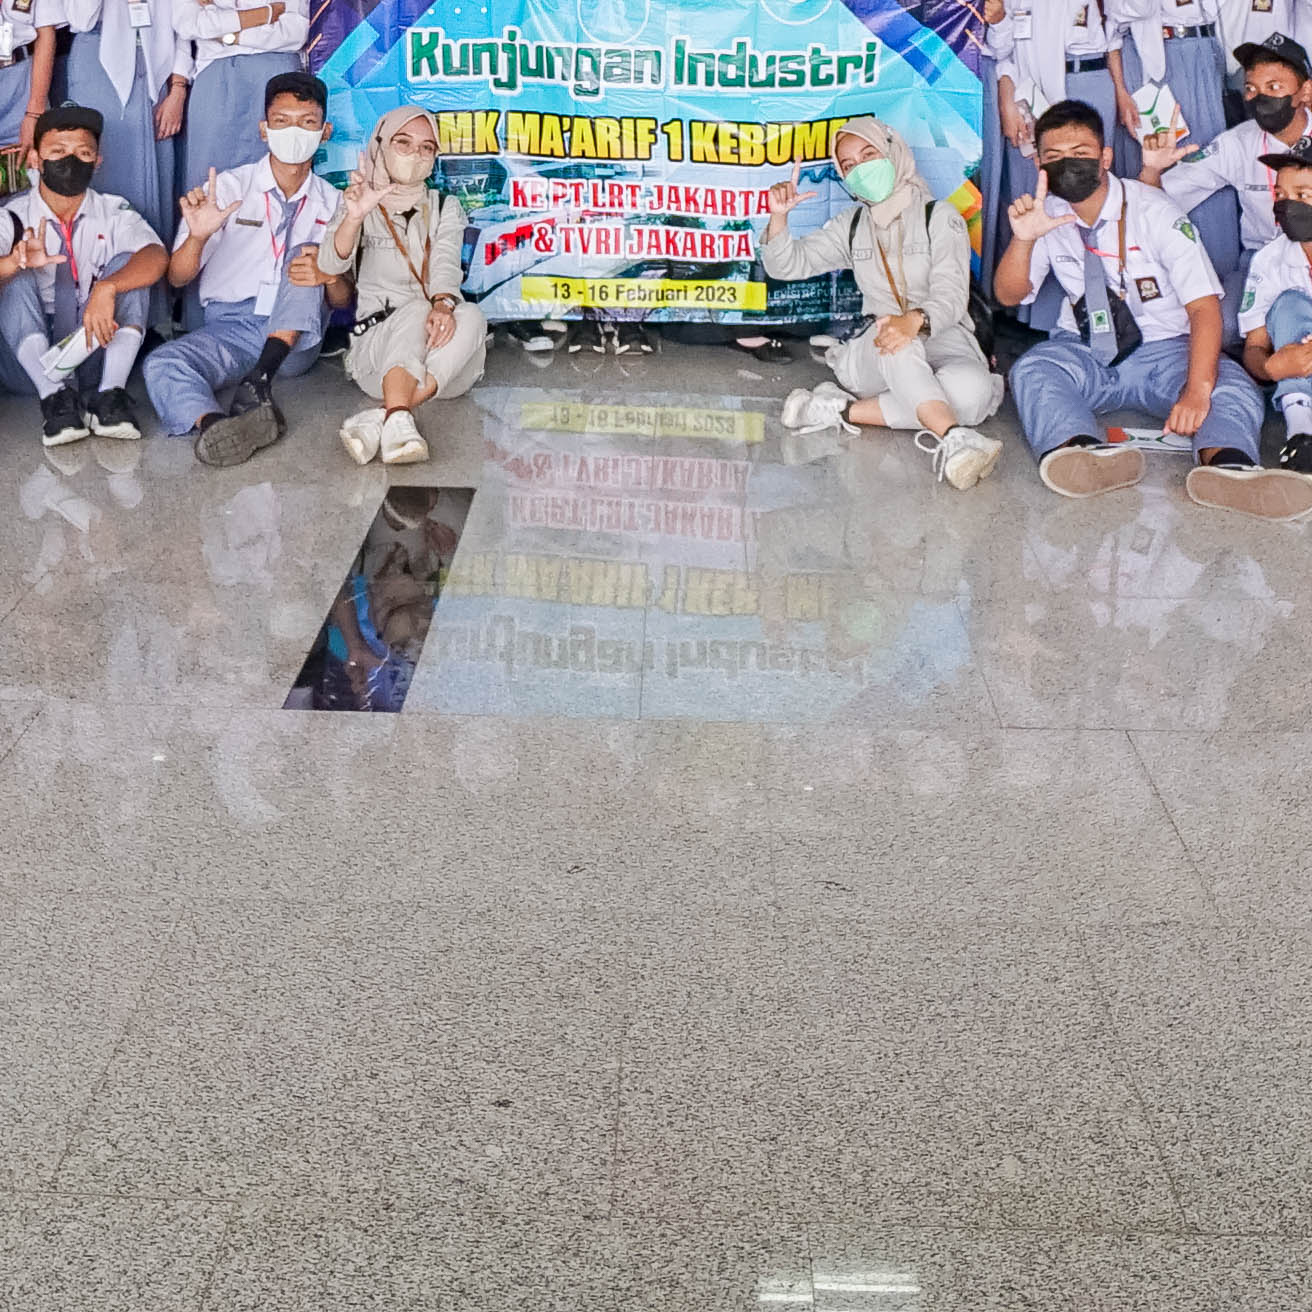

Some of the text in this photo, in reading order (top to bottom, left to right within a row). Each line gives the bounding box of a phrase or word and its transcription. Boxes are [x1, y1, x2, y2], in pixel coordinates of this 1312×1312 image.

[410, 29, 878, 98] Kunjungan Industri
[430, 109, 876, 167] MK MA'ARIF 1 KEBUM
[511, 179, 772, 216] KE PT LRT JAKARTA
[533, 226, 753, 259] & TVRI JAKARTA
[552, 283, 571, 299] 13
[588, 284, 609, 301] 16
[615, 284, 689, 303] Februari
[694, 285, 738, 304] 2023
